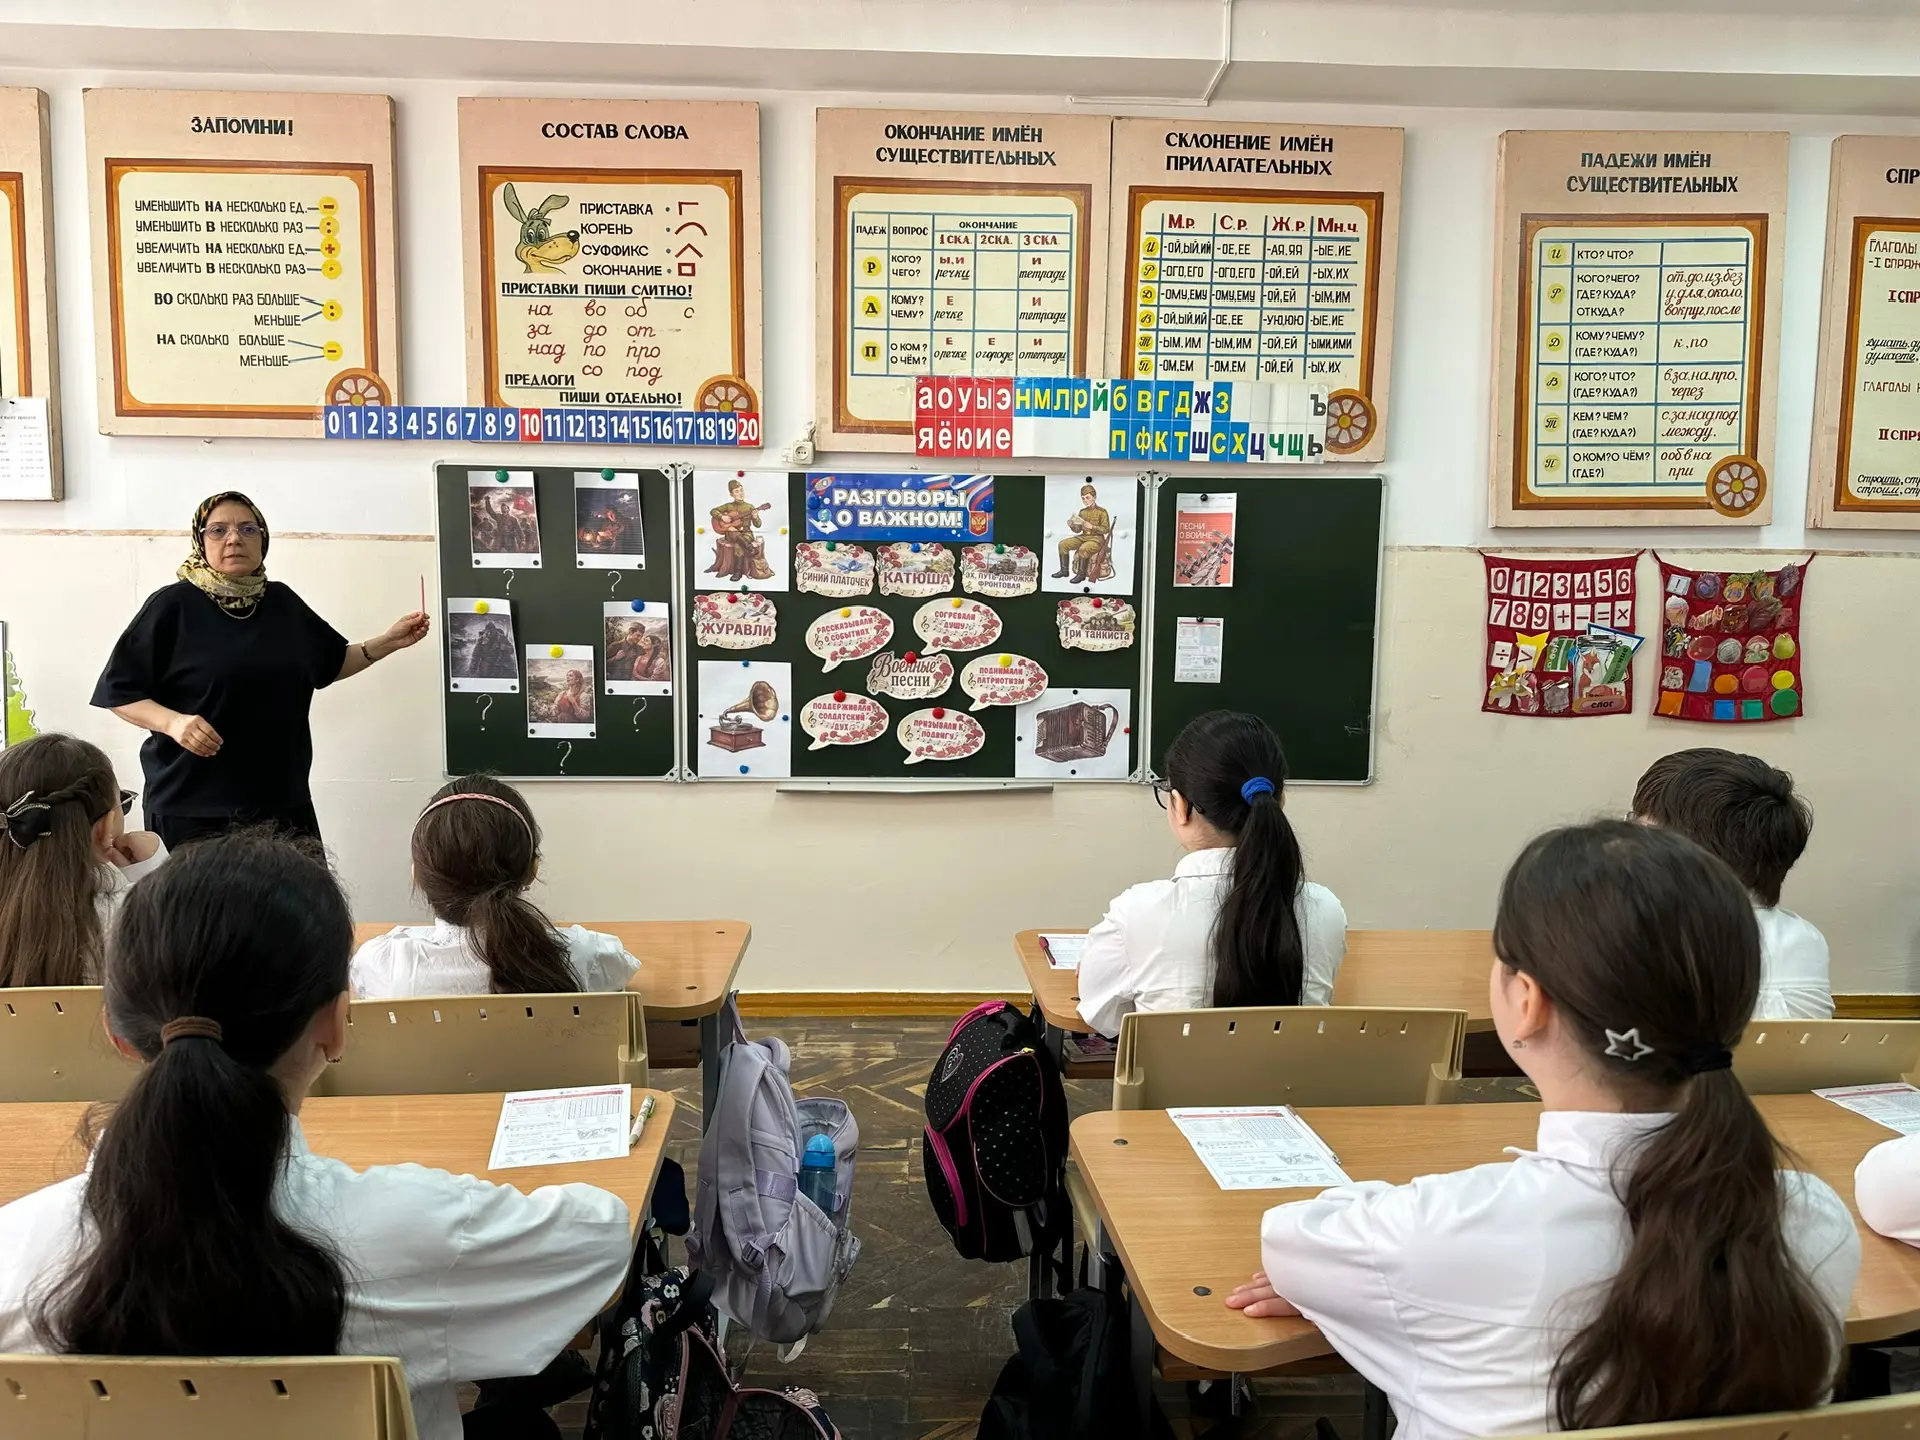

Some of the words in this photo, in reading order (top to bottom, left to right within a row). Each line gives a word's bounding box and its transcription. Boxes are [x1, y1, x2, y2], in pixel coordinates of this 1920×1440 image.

[191, 116, 293, 136] ЗАПОМНИ!
[542, 123, 619, 139] СОСТАВ
[624, 124, 689, 140] СЛОВА
[884, 125, 985, 142] ОКОНЧАНИЕ
[992, 124, 1043, 143] ИМЁН
[1165, 132, 1271, 150] СКЛОНЕНИЕ
[1280, 133, 1334, 153] ИМЁН
[876, 147, 1057, 166] СУЩЕСТВИТЕЛЬНЫХ
[1581, 152, 1658, 169] ПАДЕЖИ
[1663, 150, 1711, 168] ИМЁН
[1165, 155, 1333, 175] ПРИЛАГАТЕЛЬНЫХ
[1566, 176, 1738, 194] СУЩЕСТВИТЕЛЬНЫХ
[135, 200, 200, 212] УМЕНЬШИТЬ
[205, 201, 223, 212] НА
[227, 201, 286, 213] НЕСКОЛЬКО
[289, 202, 308, 214] ЕД.
[579, 203, 653, 215] ПРИСТАВКА
[135, 220, 201, 233] УМЕНЬШИТЬ
[206, 221, 215, 233] В
[220, 221, 279, 233] НЕСКОЛЬКО
[283, 221, 304, 233] РАЗ
[580, 223, 633, 235] КОРЕНЬ
[856, 225, 887, 235] ПАДЕЖ
[892, 226, 929, 236] ВОПРОС
[959, 221, 1018, 229] ОКОНЧАНИЕ
[136, 242, 200, 254] УВЕЛИЧИТЬ
[205, 243, 223, 254] НА
[226, 243, 284, 255] НЕСКОЛЬКО
[288, 243, 308, 256] ЕД.
[581, 244, 649, 257] СУФФИКС
[1869, 239, 1917, 254] ГЛАГОЛЫ
[891, 255, 922, 264] КОГО?
[1577, 250, 1605, 259] КТО?
[1607, 250, 1634, 259] ЧТО?
[137, 262, 201, 274] УВЕЛИЧИТЬ
[206, 263, 215, 274] В
[219, 263, 281, 274] НЕСКОЛЬКО
[285, 263, 306, 275] РАЗ
[582, 264, 662, 276] ОКОНЧАНИЕ
[892, 269, 921, 277] ЧЕГО?
[935, 269, 971, 280] речки
[1018, 270, 1066, 283] тетради
[501, 282, 579, 294] ПРИСТАВКИ
[584, 284, 626, 296] ПИШИ
[631, 284, 693, 297] СЛИТНО!
[1576, 290, 1601, 299] ГДЕ?
[1603, 290, 1636, 299] КУДА?
[154, 292, 174, 305] ВО
[177, 292, 228, 305] СКОЛЬКО
[232, 293, 254, 306] РАЗ
[257, 293, 300, 306] БОЛЬШЕ
[527, 304, 553, 316] на
[584, 299, 606, 317] во
[625, 297, 651, 318] об
[684, 307, 695, 319] с
[1576, 307, 1625, 317] ОТКУДА?
[254, 315, 301, 326] МЕНЬШЕ
[933, 311, 964, 321] речке
[1019, 311, 1066, 324] тетради
[156, 334, 176, 345] НА
[180, 334, 229, 346] СКОЛЬКО
[239, 335, 285, 346] БОЛЬШЕ
[527, 324, 552, 339] за
[583, 325, 607, 343] до
[627, 325, 656, 338] от
[527, 343, 566, 364] над
[583, 344, 606, 357] по
[626, 344, 660, 364] про
[240, 355, 289, 367] МЕНЬШЕ
[505, 374, 575, 386] ПРЕДЛОГИ
[582, 365, 603, 377] со
[626, 365, 663, 386] под
[1574, 372, 1607, 381] КОГО?
[1609, 372, 1636, 381] ЧТО?
[559, 392, 600, 404] ПИШИ
[605, 392, 682, 405] ОТДЕЛЬНО!
[1671, 386, 1704, 400] через
[328, 411, 340, 434] 0
[349, 411, 357, 434] 1
[367, 411, 379, 435] 2
[387, 412, 398, 435] 3
[406, 412, 419, 435] 4
[426, 413, 437, 435] 5
[446, 413, 457, 435] 6
[465, 413, 476, 436] 7
[484, 413, 496, 436] 8
[504, 413, 516, 436] 9
[522, 413, 540, 436] 10
[544, 414, 561, 437] 11
[566, 415, 585, 438] 12
[588, 415, 607, 438] 13
[610, 416, 629, 439] 14
[632, 416, 650, 439] 15
[654, 416, 673, 440] 16
[676, 417, 694, 440] 17
[696, 417, 715, 440] 18
[718, 418, 736, 440] 19
[738, 418, 758, 441] 20
[1572, 468, 1604, 478] (ГДЕ?)
[1668, 466, 1693, 480] при
[833, 488, 966, 507] РАЗГОВОРЫ
[836, 510, 852, 527] О
[858, 510, 963, 528] ВАЖНОМ!
[1180, 522, 1206, 530] ПЕСНИ
[1180, 531, 1185, 539] О
[1185, 530, 1213, 539] ВОЙНЕ
[802, 572, 829, 584] СИНИЙ
[830, 573, 870, 588] ПЛАТОЧЕК
[883, 572, 950, 585] КАТЮША
[978, 580, 1021, 589] ФРОНТОВАЯ
[1493, 569, 1507, 591] 0
[1516, 573, 1525, 595] 1
[1534, 575, 1549, 597] 2
[1556, 575, 1569, 597] 3
[1576, 575, 1589, 597] 4
[1598, 571, 1610, 593] 5
[1617, 571, 1630, 593] 6
[934, 610, 976, 620] СОГРЕВАЛИ
[701, 622, 772, 637] ЖУРАВЛИ
[816, 618, 873, 634] РАССКАЗЫВАЛИ
[824, 635, 830, 643] О
[830, 629, 870, 641] СОБЫТИЯХ
[1064, 626, 1082, 639] Три
[1085, 630, 1130, 640] танкиста
[874, 653, 937, 677] Военные
[979, 667, 1023, 675] ПОДНИМАЛИ
[891, 675, 930, 687] песни
[976, 677, 1025, 685] ПАТРИОТИЗМ
[812, 702, 872, 712] ПОДДЕРЖИВАЛИ
[1590, 701, 1614, 709] слог
[818, 712, 865, 721] СОЛДАТСКИЙ
[834, 723, 849, 731] ДУХ
[913, 719, 957, 730] ПРИЗЫВАЛИ
[921, 731, 954, 740] ПОДВИГУ
